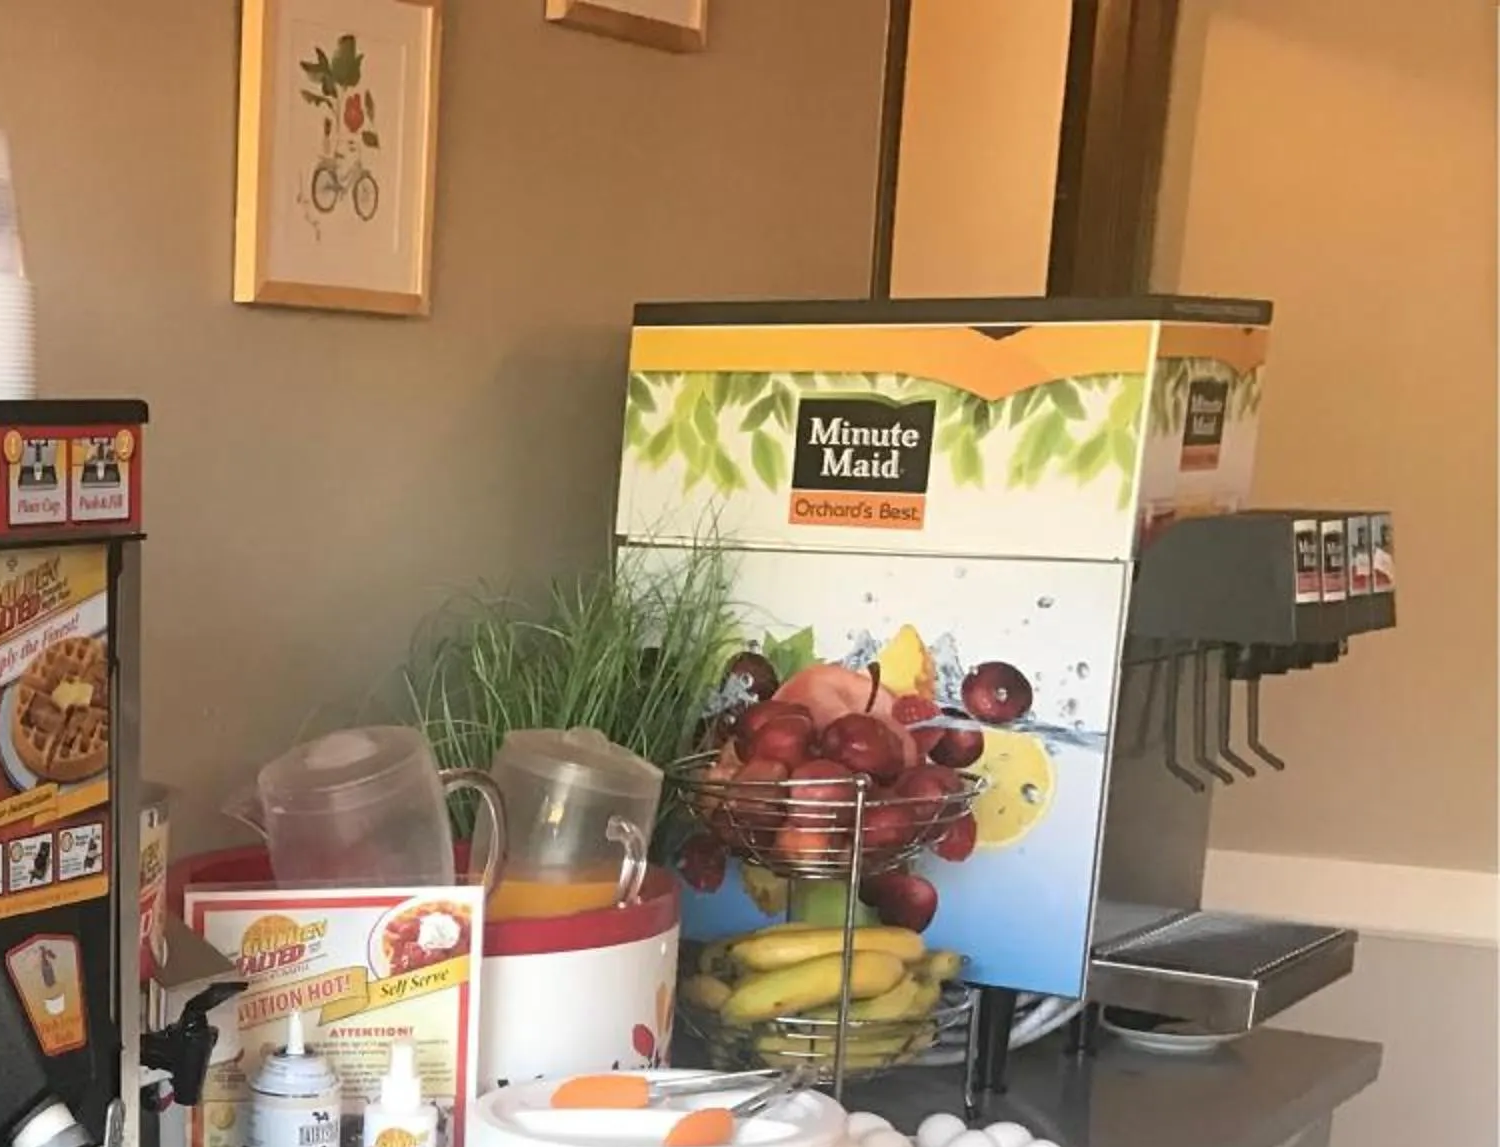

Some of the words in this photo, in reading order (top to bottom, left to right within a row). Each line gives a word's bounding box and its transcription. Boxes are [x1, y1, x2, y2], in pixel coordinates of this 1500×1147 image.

[808, 417, 920, 448] Minute
[819, 447, 900, 479] Maid
[795, 498, 873, 519] Orchard's
[308, 974, 351, 1001] HOT!
[380, 979, 408, 998] Self
[410, 968, 449, 989] Serve
[329, 1026, 414, 1038] ATTENTION!
